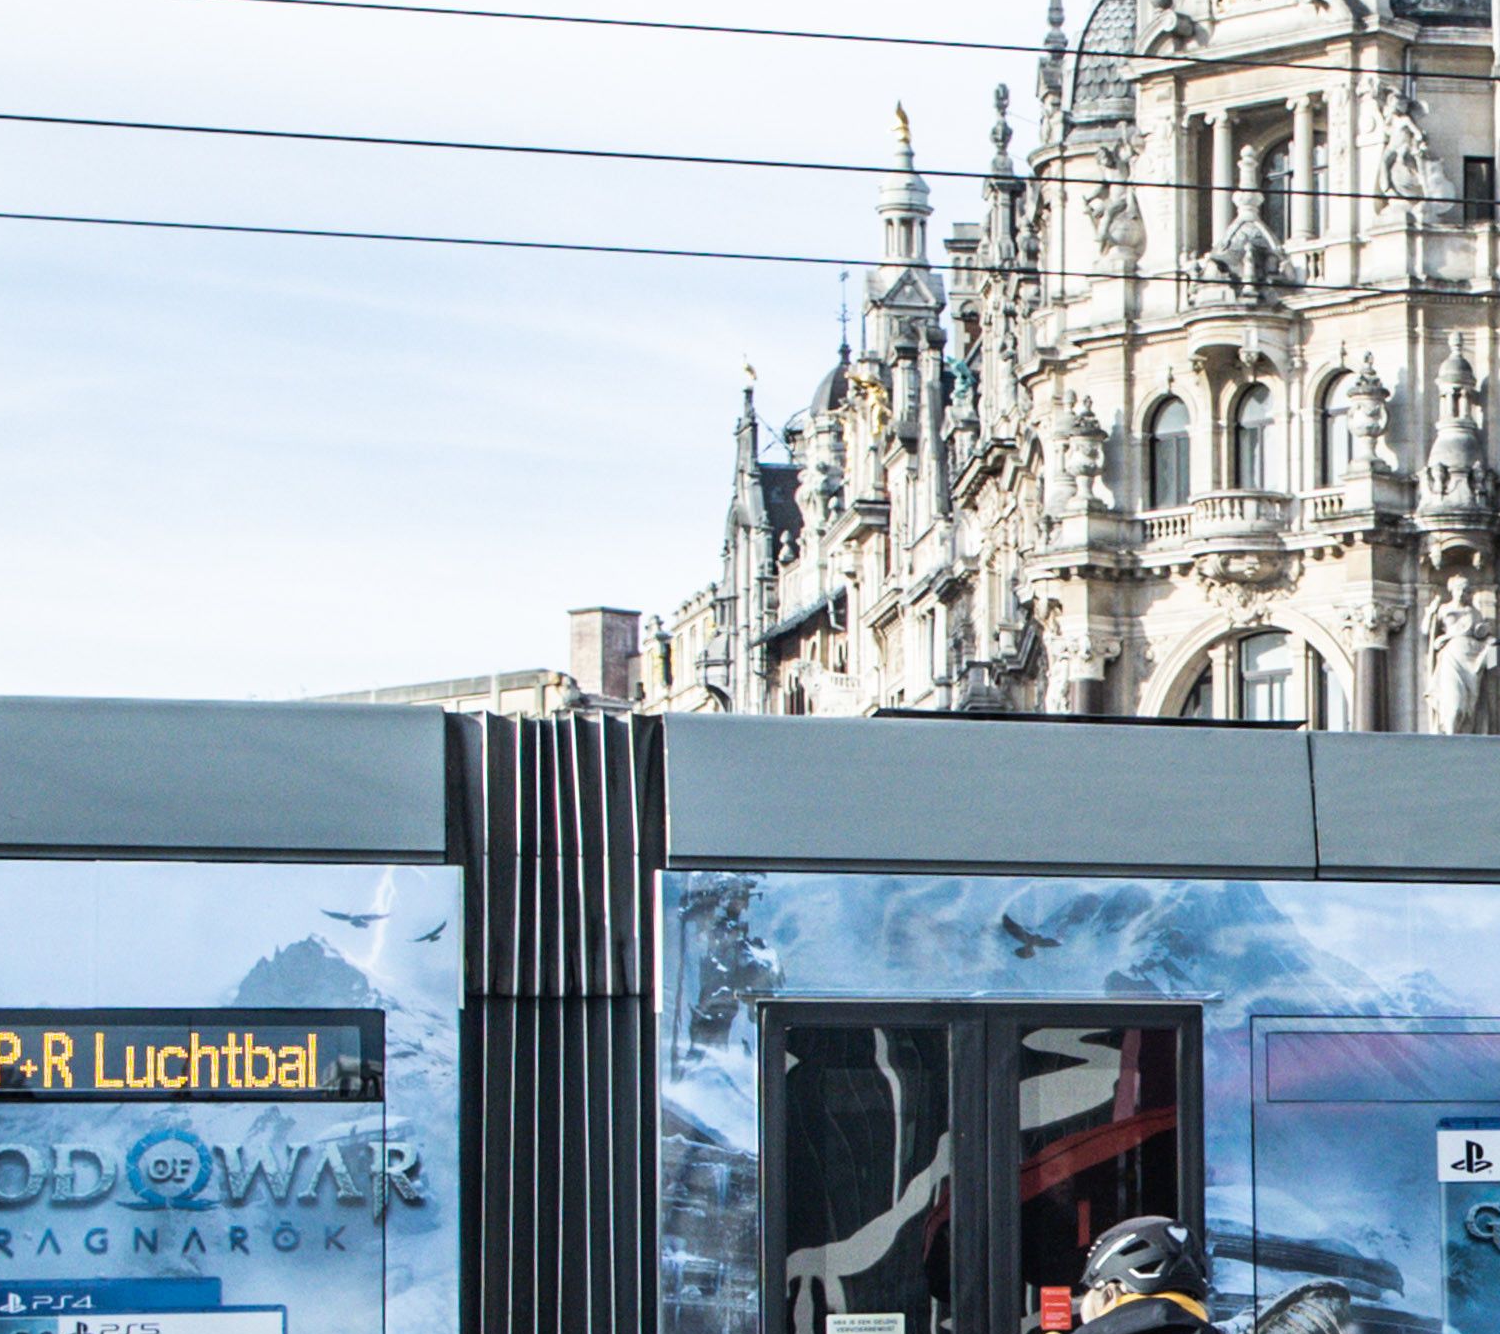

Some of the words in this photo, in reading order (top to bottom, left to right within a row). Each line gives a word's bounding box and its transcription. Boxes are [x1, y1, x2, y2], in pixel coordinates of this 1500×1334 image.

[94, 1031, 318, 1089] Luchtbal
[147, 1154, 194, 1184] OF
[213, 1140, 426, 1224] WAR
[32, 1294, 94, 1310] PS4
